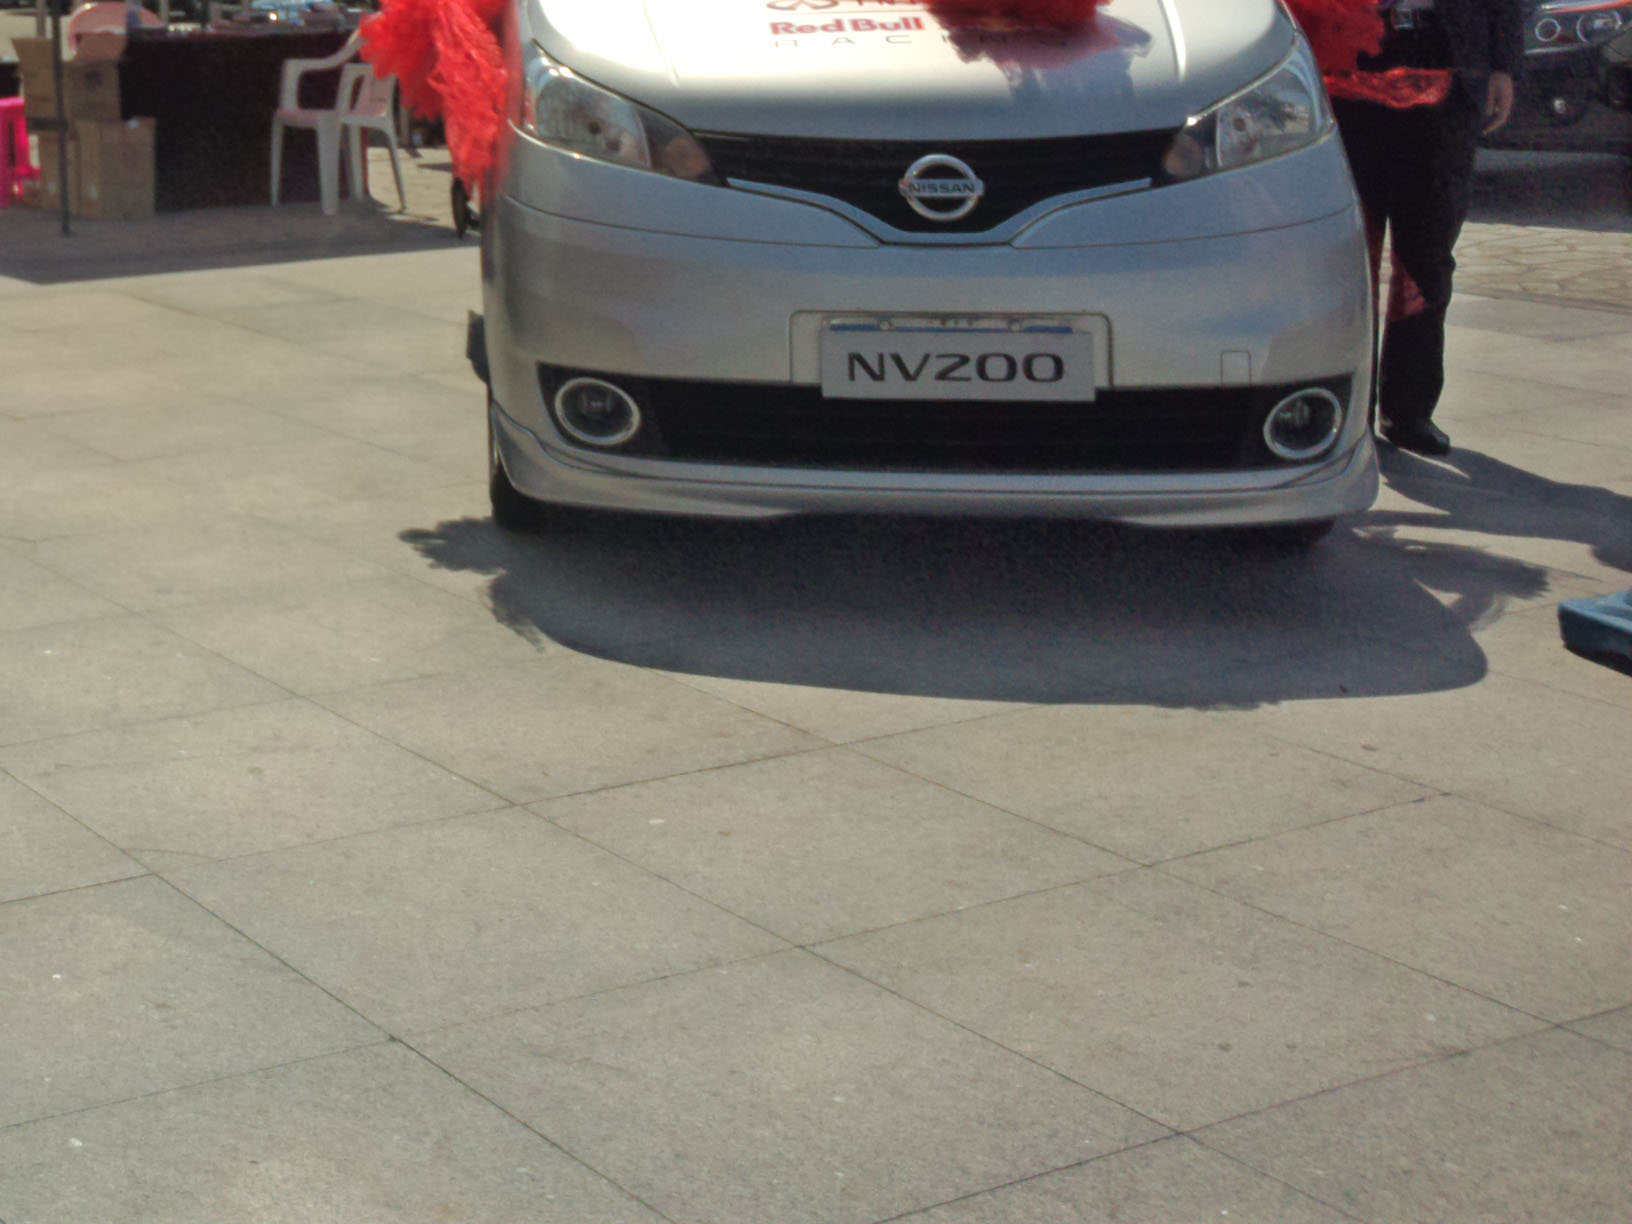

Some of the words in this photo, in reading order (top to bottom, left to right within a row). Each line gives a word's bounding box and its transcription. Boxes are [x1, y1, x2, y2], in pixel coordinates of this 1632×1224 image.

[769, 19, 843, 36] Red
[848, 16, 925, 32] Bull
[910, 182, 975, 194] NISSAN
[848, 351, 1065, 383] NV200
